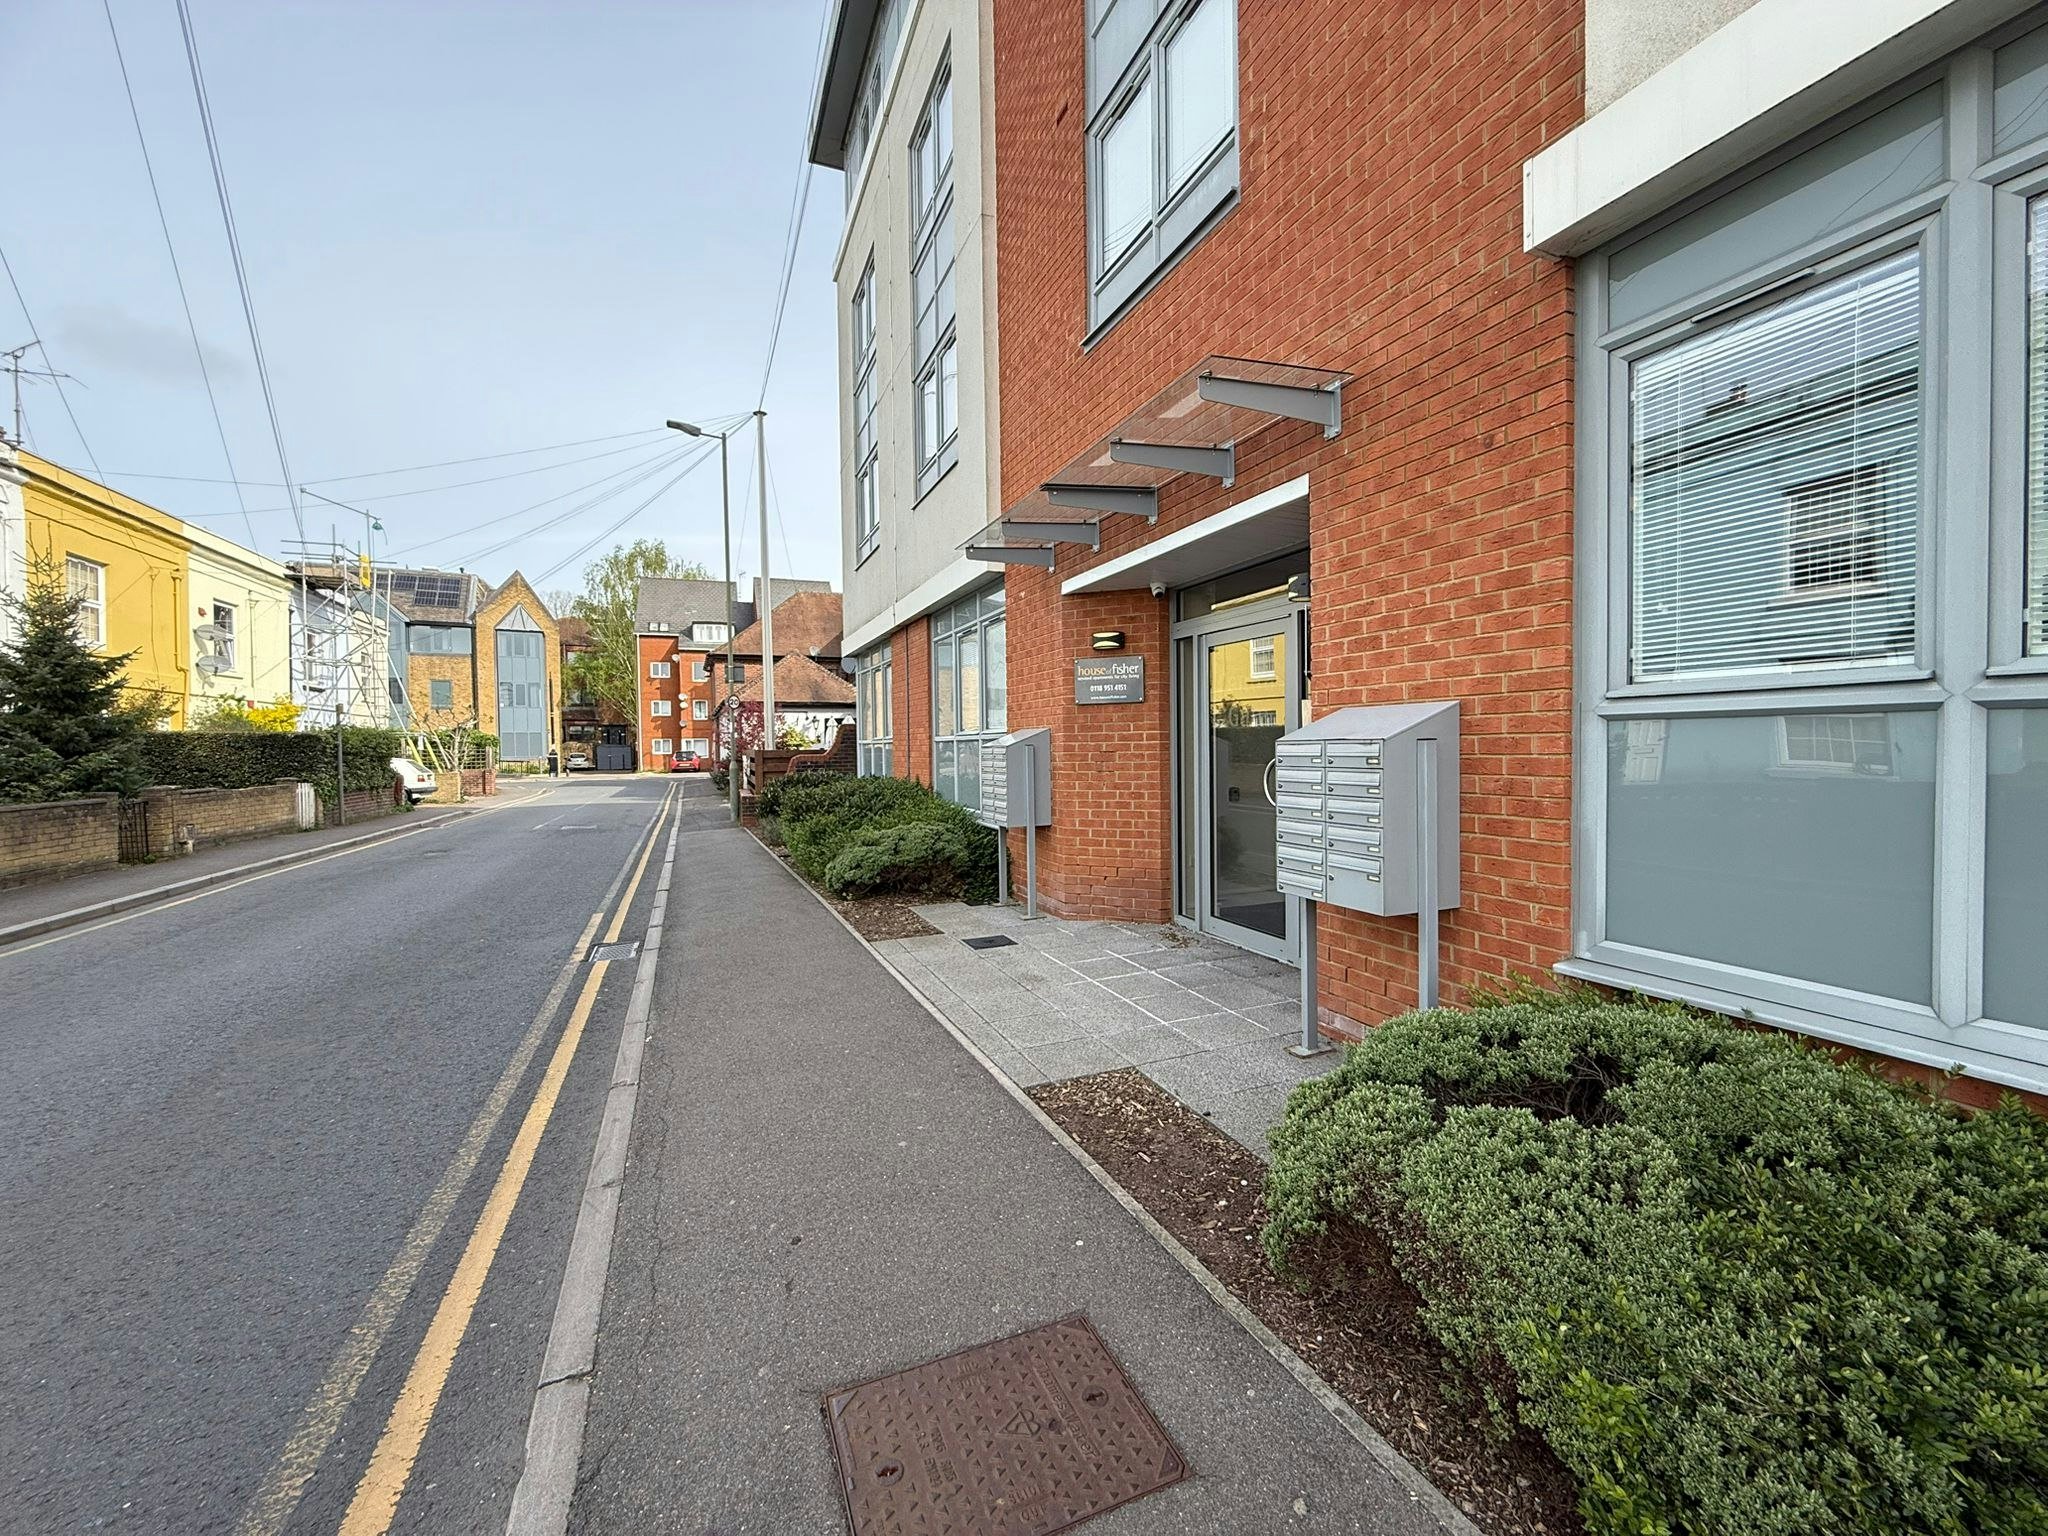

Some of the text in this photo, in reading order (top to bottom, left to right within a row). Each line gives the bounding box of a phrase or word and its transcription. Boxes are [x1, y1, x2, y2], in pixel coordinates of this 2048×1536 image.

[1078, 665, 1105, 676] house
[1112, 663, 1139, 674] fisher
[1090, 684, 1103, 692] 0118
[1064, 1410, 1099, 1458] Water
